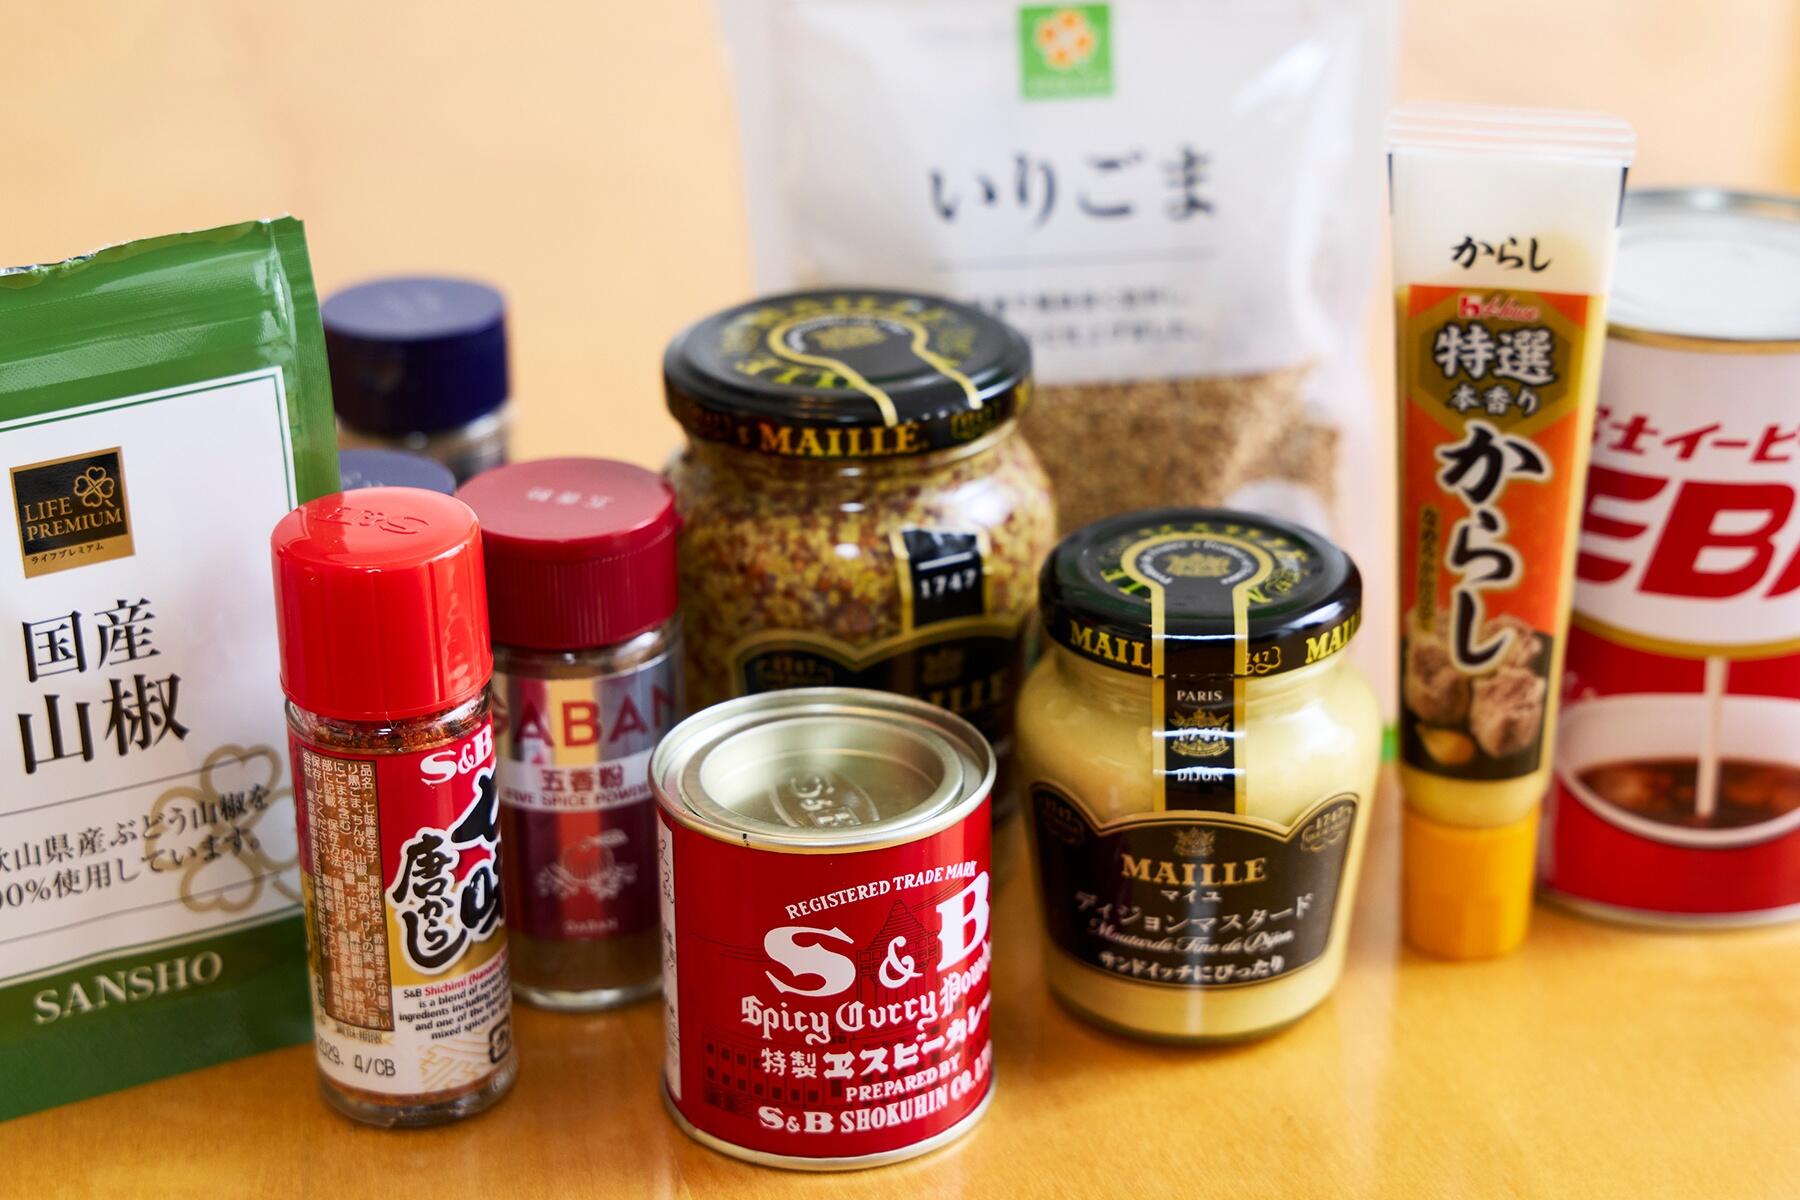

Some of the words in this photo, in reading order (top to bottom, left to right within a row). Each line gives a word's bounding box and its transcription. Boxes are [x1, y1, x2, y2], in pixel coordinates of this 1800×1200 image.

[928, 145, 1216, 231] いりごま
[1451, 235, 1552, 272] からし
[1436, 323, 1556, 385] 特選
[1451, 385, 1539, 415] 本香り
[759, 422, 919, 456] MAILLE
[24, 497, 73, 522] LIFE
[27, 507, 123, 541] PREMIUM
[1438, 422, 1547, 668] からし
[1576, 462, 1800, 600] EB
[32, 544, 104, 564] ライフプレミアム
[919, 569, 977, 598] 1747
[22, 598, 160, 683] 国産
[1070, 620, 1151, 669] MAIL
[1176, 690, 1223, 701] PARIS
[18, 673, 190, 774] 山椒
[420, 724, 493, 785] S&B
[541, 765, 623, 792] 五香粉
[542, 795, 587, 806] SPICE
[0, 829, 261, 910] 0%使用しています。
[1122, 854, 1266, 885] MAILLE
[785, 879, 891, 920] REGISTERED
[893, 869, 943, 891] TRADE
[944, 860, 978, 881] MARK
[1161, 889, 1222, 902] マイユ
[1076, 892, 1313, 933] ディジョンマスタード
[1089, 918, 1174, 951] Moutarde
[1175, 937, 1219, 952] Fine
[1221, 936, 1242, 952] de
[1243, 930, 1294, 953] Dijon
[1100, 951, 1285, 982] サンドイッチにぴったり
[33, 951, 223, 1024] SANSHO
[403, 988, 422, 999] S&B
[424, 977, 466, 996] Shichimi
[419, 1000, 427, 1009] is
[438, 991, 466, 1005] blend
[469, 985, 478, 995] of
[399, 1008, 450, 1022] ingredients
[452, 992, 491, 1012] including
[415, 1022, 433, 1032] and
[436, 1018, 455, 1028] one
[457, 1013, 467, 1022] of
[470, 1006, 484, 1017] the
[741, 995, 830, 1045] Spicy
[835, 990, 938, 1033] Curry
[431, 1027, 461, 1040] mixed
[463, 1016, 489, 1033] spices
[761, 1047, 817, 1078] 特製
[846, 1067, 938, 1102] PREPARED
[939, 1054, 963, 1080] BY
[758, 1106, 834, 1133] S&B
[840, 1084, 948, 1133] SHOKUHIN
